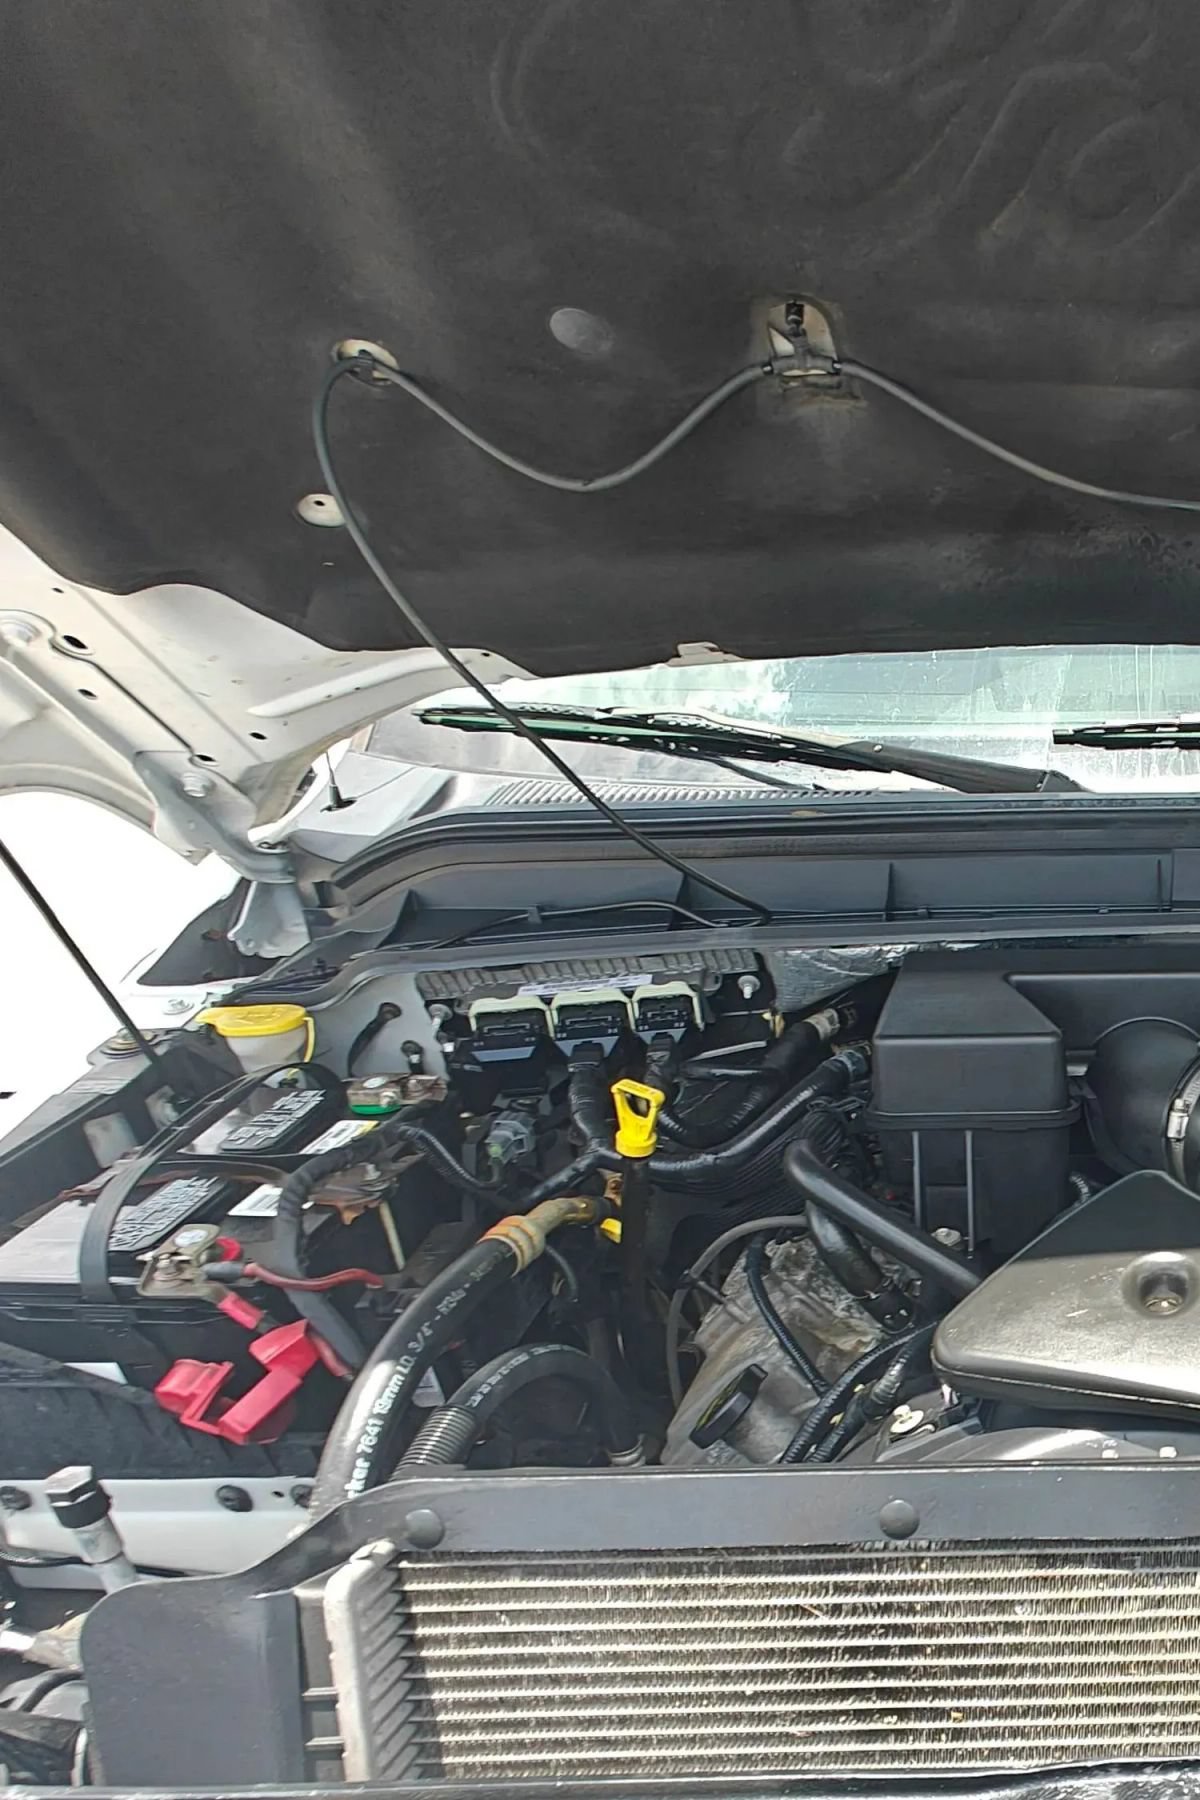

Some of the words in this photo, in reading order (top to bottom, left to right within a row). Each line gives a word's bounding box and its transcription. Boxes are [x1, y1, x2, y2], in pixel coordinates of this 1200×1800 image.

[373, 1374, 405, 1414] 19mm
[356, 1418, 384, 1453] 7641
[344, 1457, 371, 1499] rker
